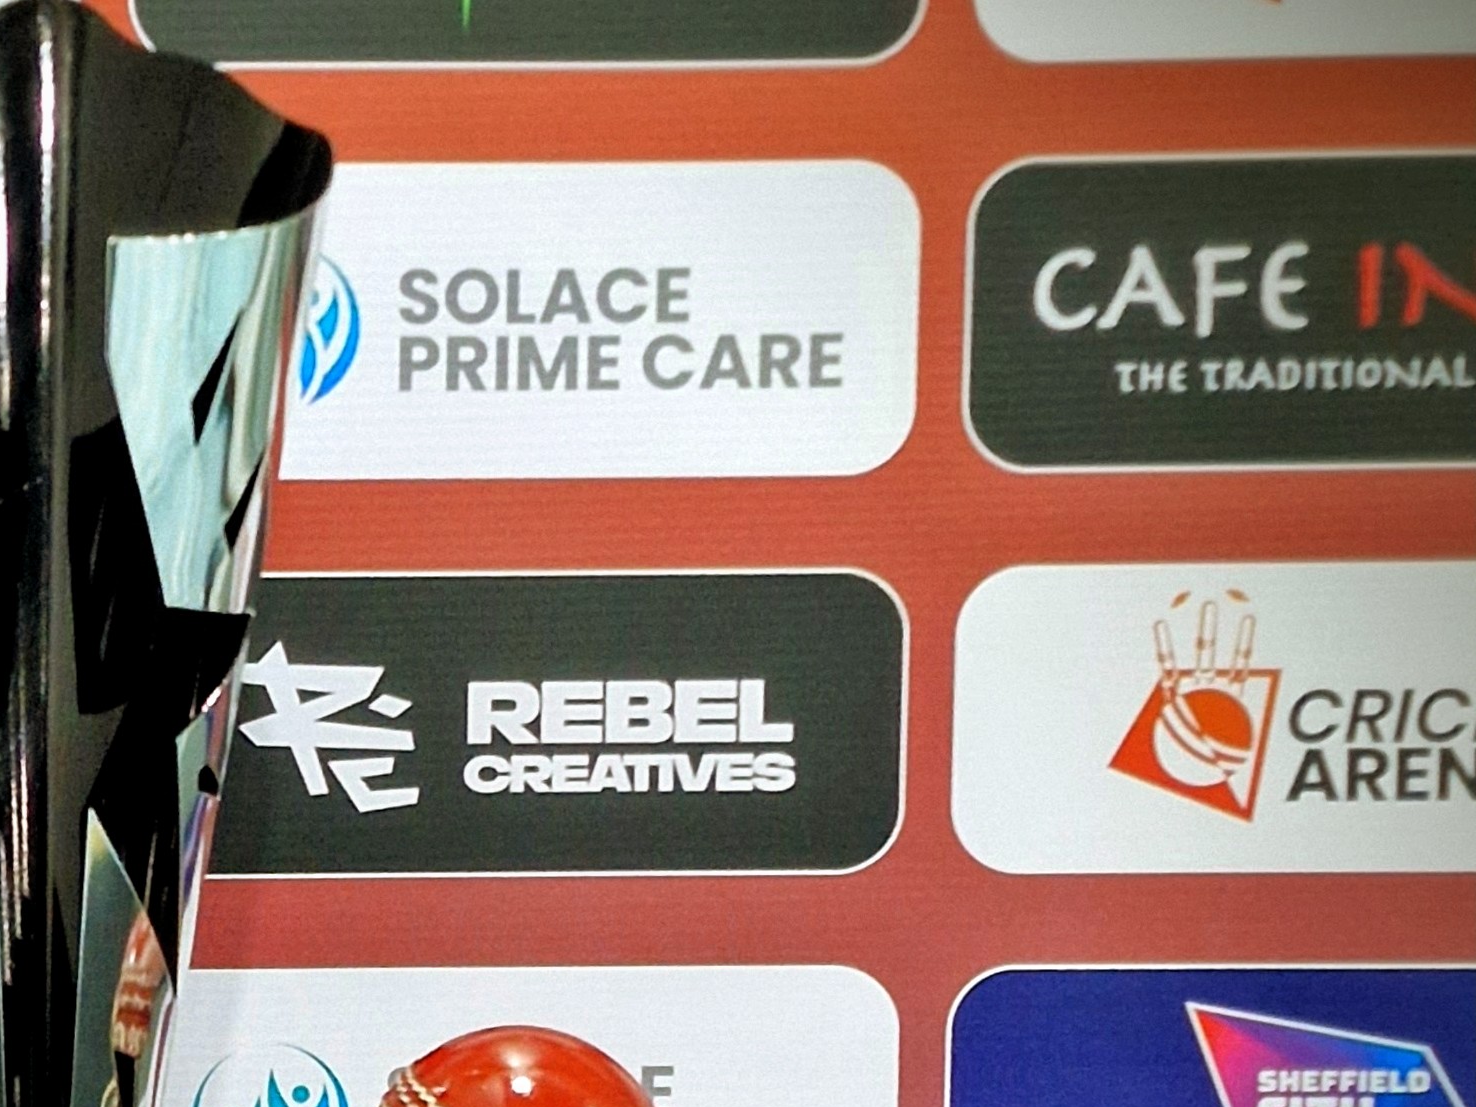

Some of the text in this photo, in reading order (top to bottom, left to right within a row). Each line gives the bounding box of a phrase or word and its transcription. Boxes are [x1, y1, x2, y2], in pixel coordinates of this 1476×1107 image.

[397, 267, 692, 324] SOLACE
[1032, 242, 1310, 338] CAFE
[398, 332, 844, 392] PRIME CARE
[1114, 355, 1476, 392] THE TRADITIONAL
[467, 680, 795, 745] REBEL
[1288, 688, 1476, 743] CRIC
[463, 753, 797, 794] CREATIVES
[1257, 1070, 1431, 1093] SHEFFIELD
